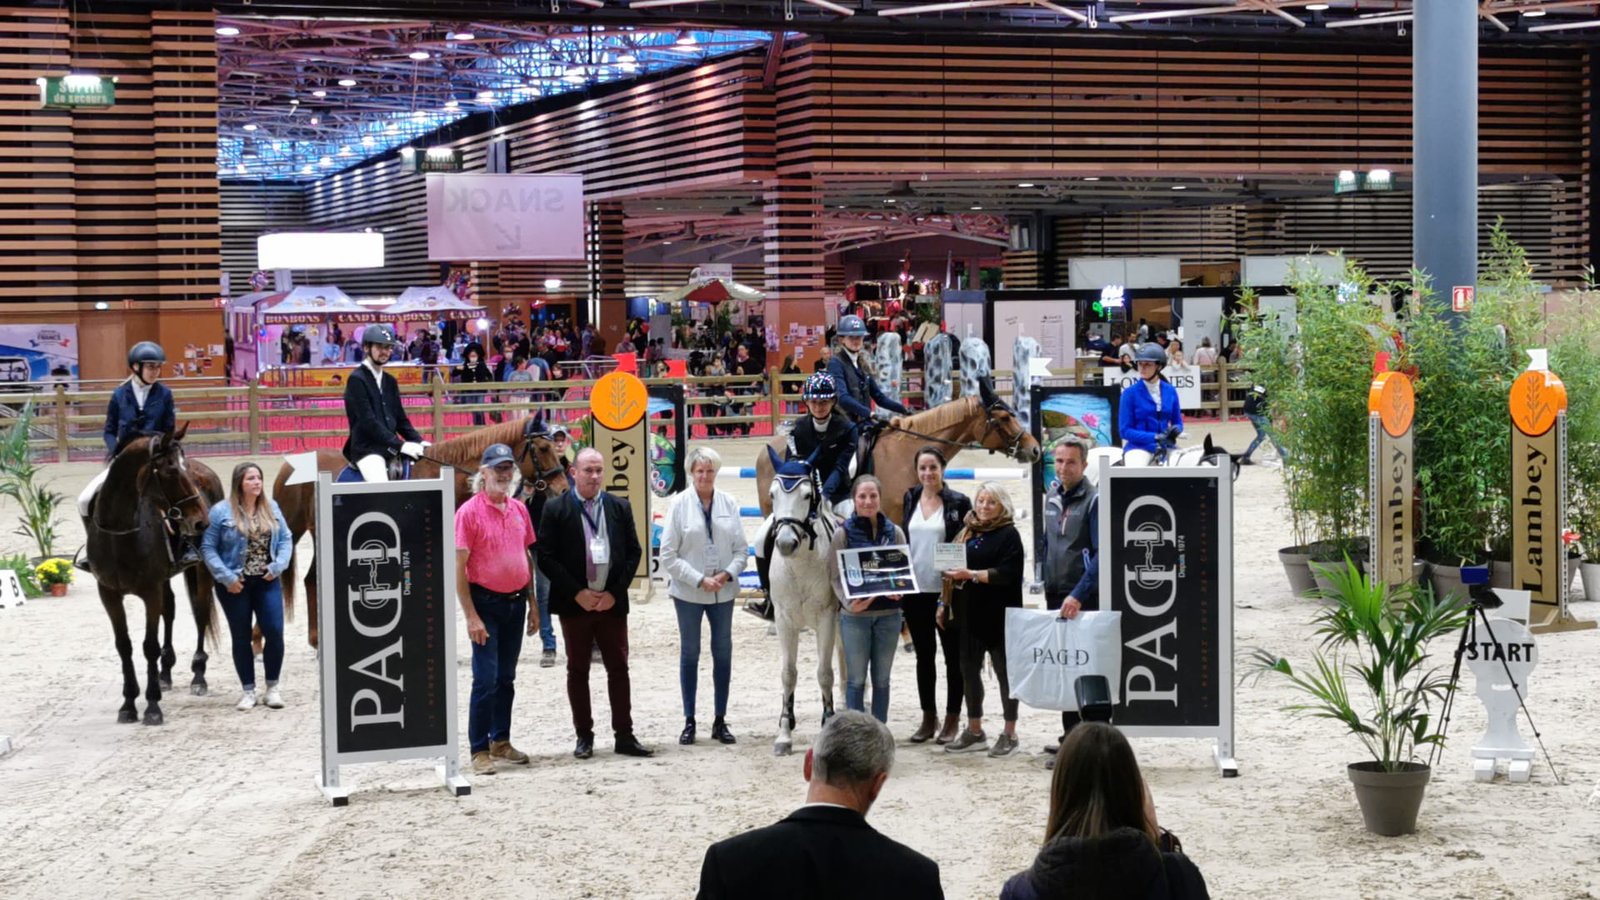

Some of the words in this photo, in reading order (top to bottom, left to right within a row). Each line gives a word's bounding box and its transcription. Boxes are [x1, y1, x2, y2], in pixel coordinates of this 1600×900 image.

[266, 315, 320, 323] BONBONS
[338, 313, 376, 322] CANDY
[380, 313, 432, 321] BONBONS
[450, 310, 487, 319] CANDY
[1388, 446, 1408, 592] Lambey
[1522, 444, 1547, 595] Lambey
[1177, 534, 1185, 552] 1974
[402, 551, 411, 569] 1974
[1467, 642, 1534, 662] START
